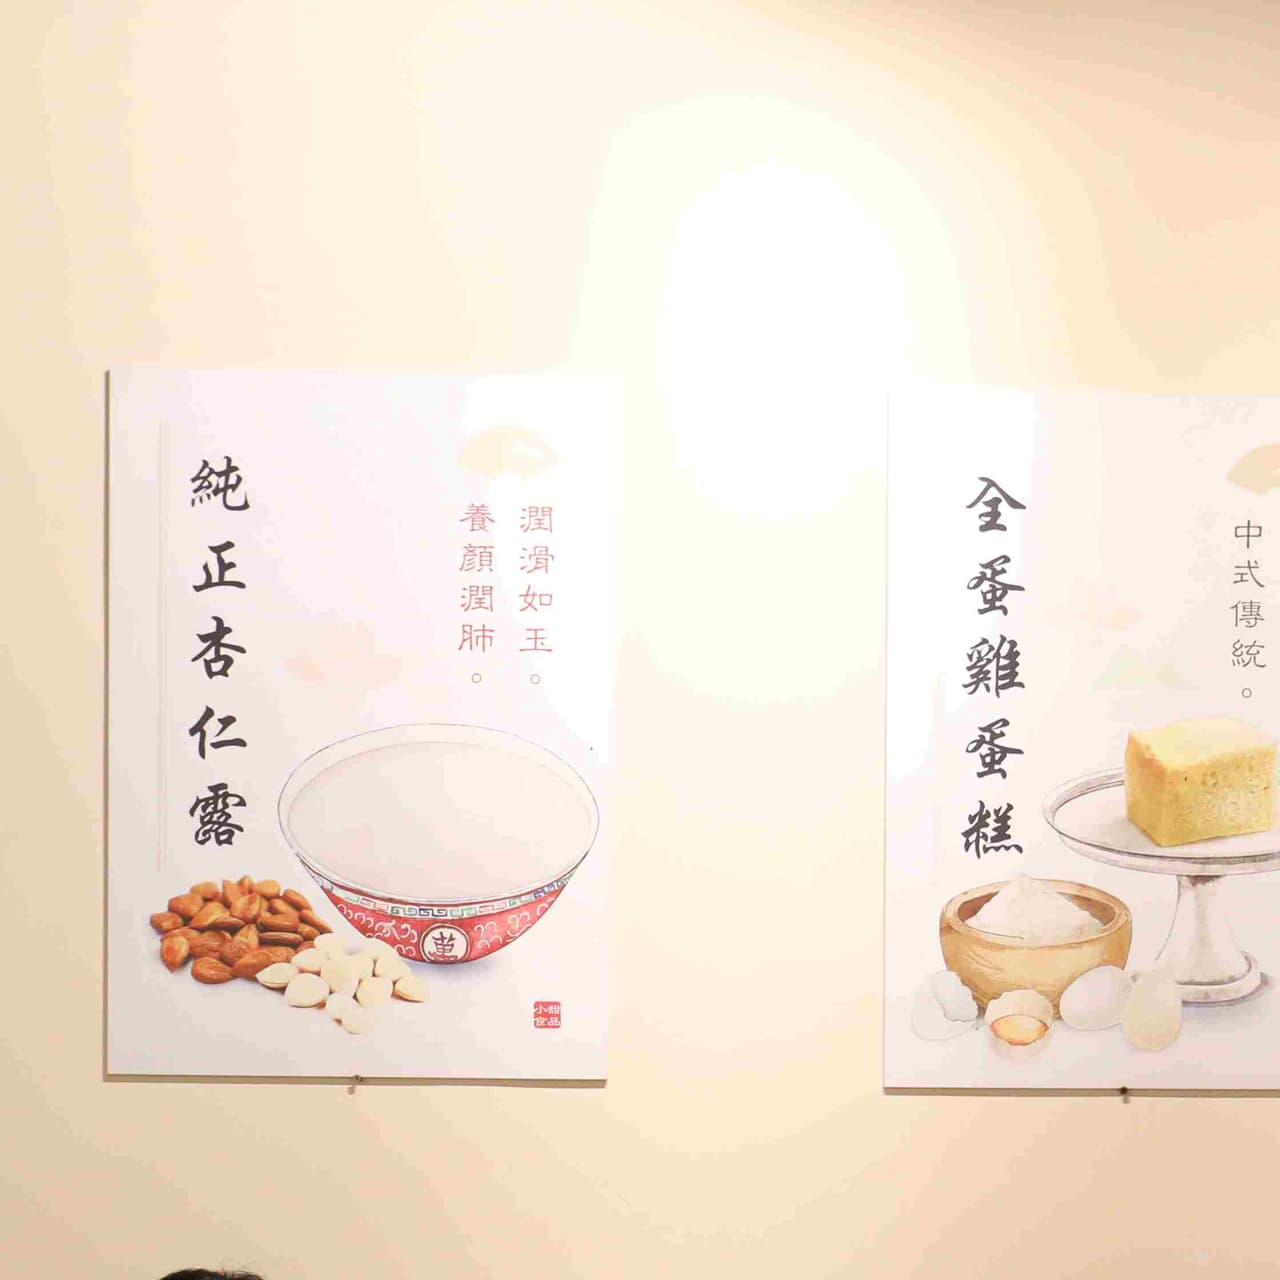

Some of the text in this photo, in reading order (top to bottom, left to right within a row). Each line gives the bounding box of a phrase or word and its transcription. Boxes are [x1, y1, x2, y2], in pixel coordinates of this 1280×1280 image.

[189, 456, 251, 846] 純正杏仁露
[458, 503, 496, 684] 養顏潤肺。
[518, 506, 555, 685] 潤滑如玉。
[961, 477, 1026, 859] 全蛋雞蛋糕
[1230, 520, 1266, 698] 中式傳統。
